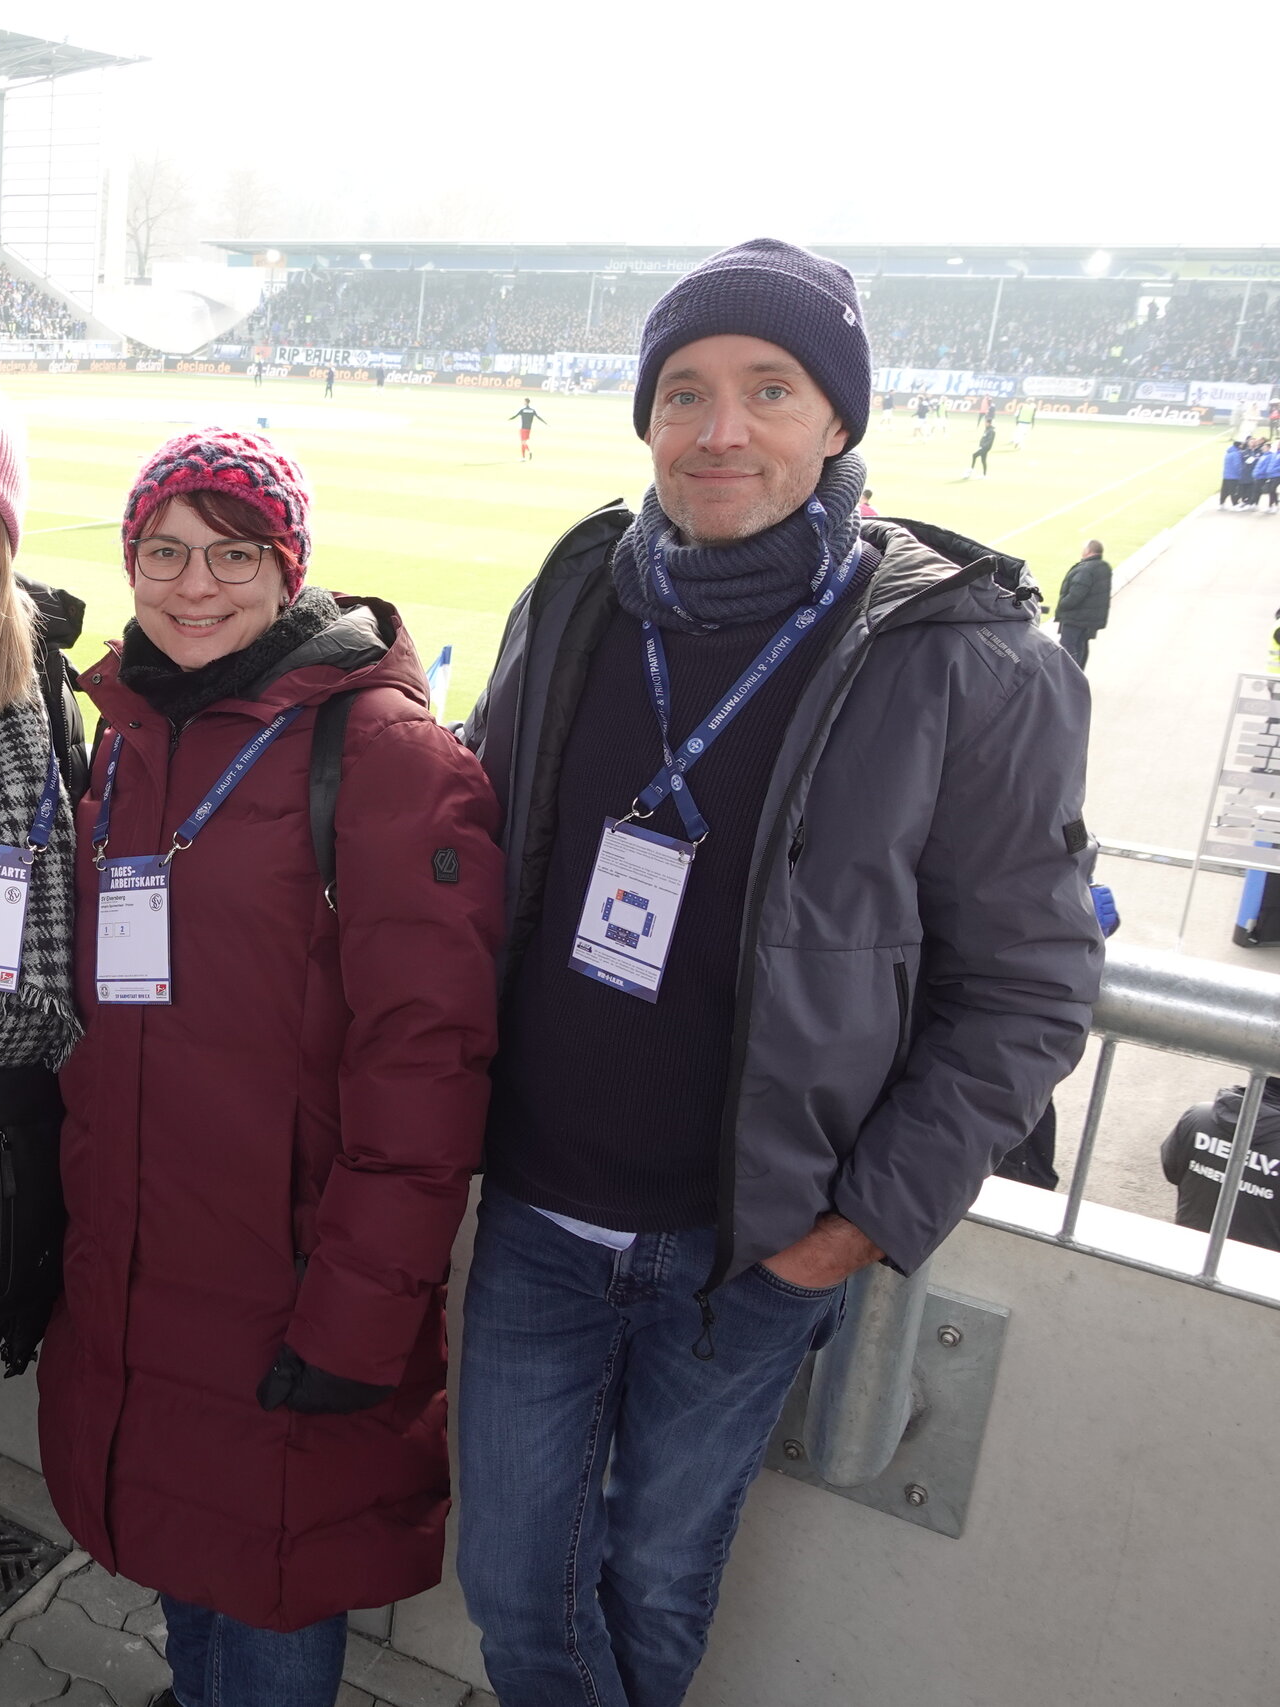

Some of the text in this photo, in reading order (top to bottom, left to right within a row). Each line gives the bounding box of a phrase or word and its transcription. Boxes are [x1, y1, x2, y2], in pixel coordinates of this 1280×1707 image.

[278, 347, 300, 362] RIP
[305, 348, 351, 365] BAUER
[48, 360, 78, 374] declaro
[136, 359, 162, 372] declaro
[176, 360, 231, 374] declaro.de
[309, 366, 369, 381] decaro.de
[386, 369, 433, 385] declaro
[455, 373, 522, 389] declaro.de
[1126, 403, 1200, 421] declaro
[646, 637, 664, 698] TRIKOTPARTNER
[707, 635, 791, 731] HAUPT- & TRIKOTPARTNER
[215, 714, 287, 796] HAUPT- & TRIKOTPARTNER
[110, 866, 136, 878] TAGES-
[110, 875, 166, 890] ARBEITSKARTE
[1194, 1131, 1232, 1160] DIE
